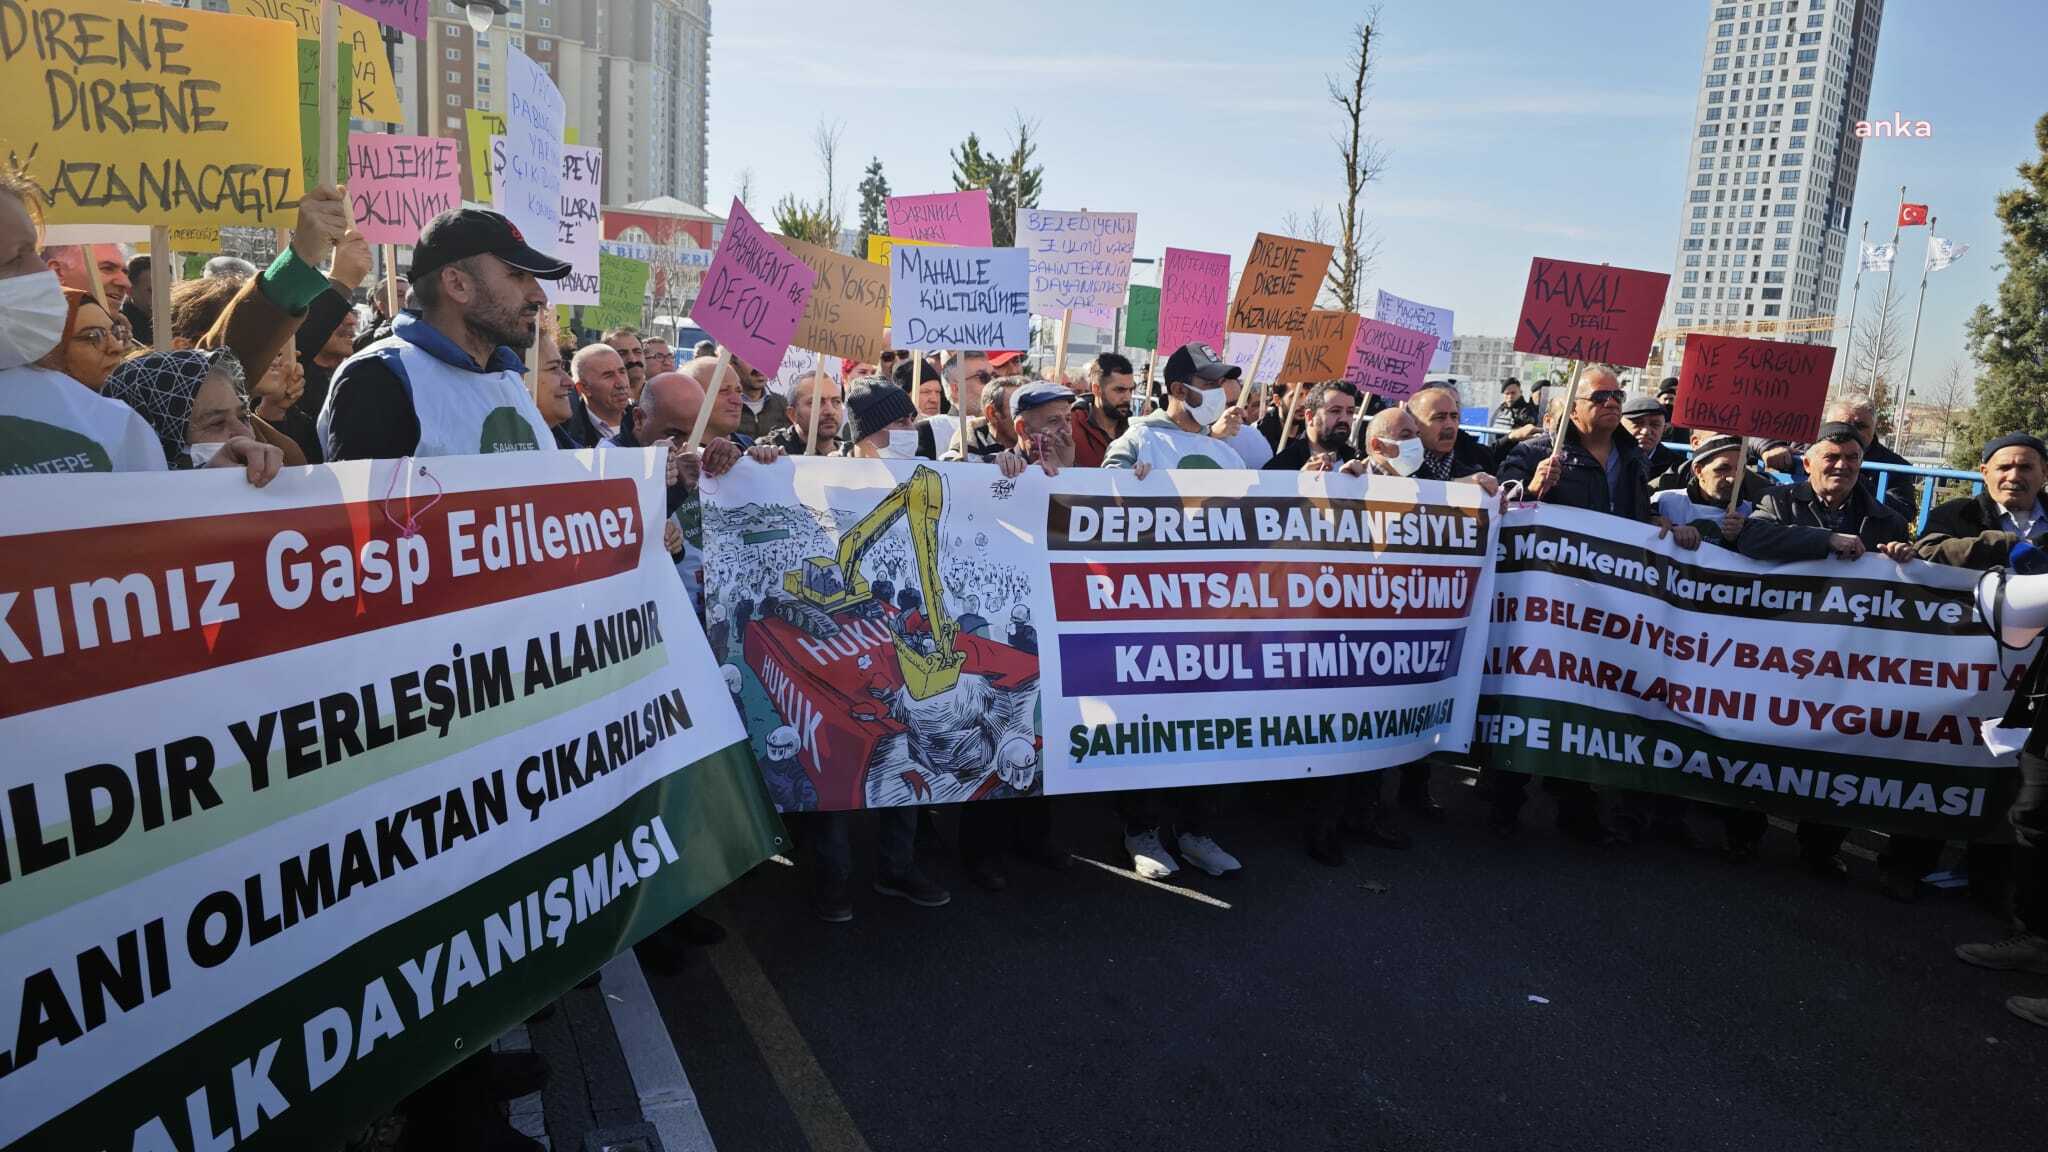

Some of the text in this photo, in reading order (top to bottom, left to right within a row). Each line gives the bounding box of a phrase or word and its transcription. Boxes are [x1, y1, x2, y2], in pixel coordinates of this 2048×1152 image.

[347, 141, 452, 180] HALLEME
[352, 187, 450, 230] OKUNMA
[891, 199, 963, 226] BARINMA
[840, 263, 888, 310] YOKSA
[900, 247, 992, 285] MAHALLE
[1533, 261, 1627, 314] KANAL
[708, 265, 776, 346] DEFOL
[905, 318, 1005, 348] DOKUNMA
[1696, 343, 1727, 369] NE
[1283, 345, 1333, 377] HAYIR
[1693, 373, 1718, 392] NE
[1068, 505, 1478, 549] DEPREM BAHANESİYLE
[265, 529, 430, 605] Gasp
[446, 502, 638, 578] Edilemez
[1514, 532, 1660, 587] Mahkeme
[1666, 564, 1813, 613] Kararları
[1819, 585, 1905, 624] Açık
[1914, 600, 1963, 624] ve
[1085, 565, 1469, 615] RANTSAL DÖNÜŞÜMÜ
[797, 611, 897, 667] HUKU
[1114, 643, 1254, 684] KABUL
[1261, 632, 1451, 680] ETMİYORUZ!
[227, 643, 516, 793] YERLEŞİM
[523, 598, 664, 698] ALANIDIR
[761, 654, 824, 774] HUKUK
[1068, 697, 1455, 764] ŞAHİNTEPE HALK DAYANIŞMASI
[1474, 713, 1986, 818] TEPE HALK DAYANIŞMASI
[0, 688, 694, 1080] ANI OLMAKTAN ÇIKARILSIN
[103, 815, 680, 1152] ALK DAYANIŞMASI
